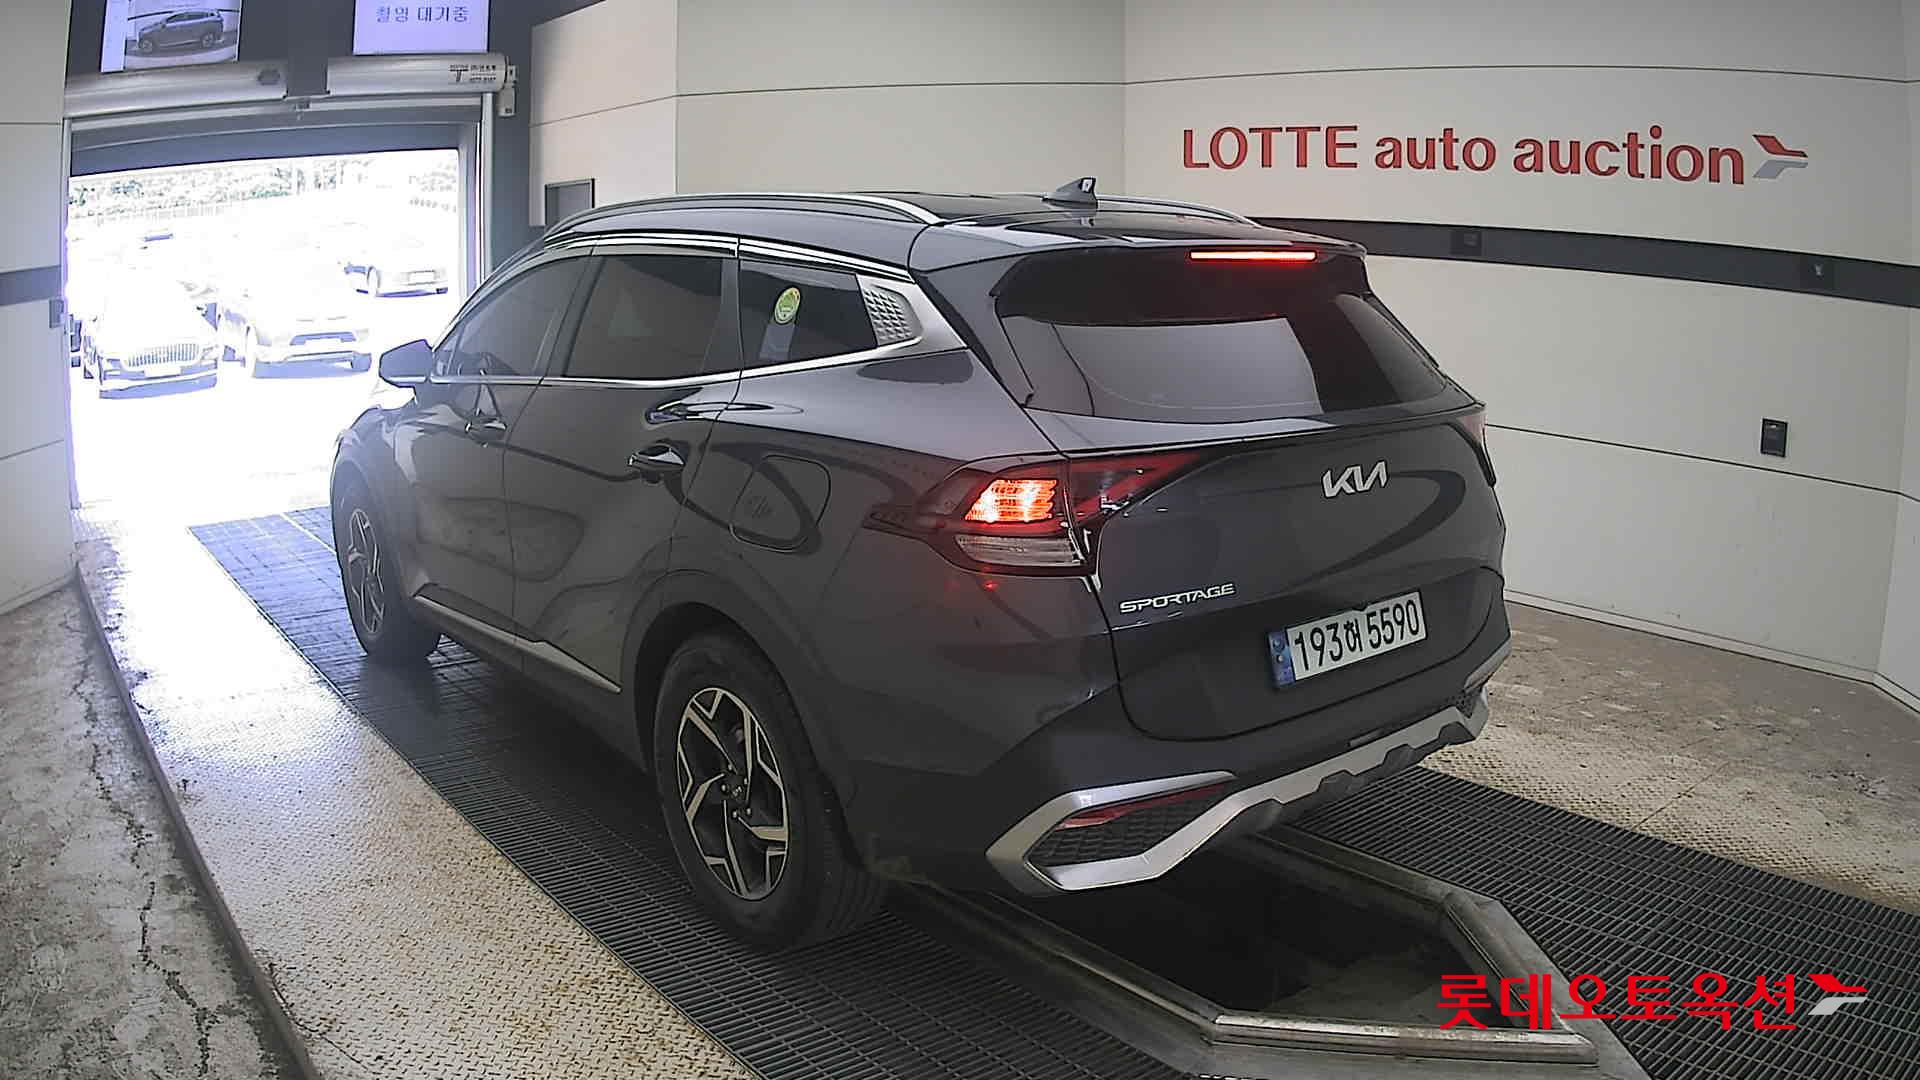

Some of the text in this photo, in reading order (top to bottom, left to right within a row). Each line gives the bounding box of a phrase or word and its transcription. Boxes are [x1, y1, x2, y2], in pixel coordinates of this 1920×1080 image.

[417, 6, 470, 23] 대기중
[1183, 125, 1745, 185] LOTTE auto auction
[1321, 460, 1389, 499] KIA
[1119, 582, 1236, 614] SPORTAGE
